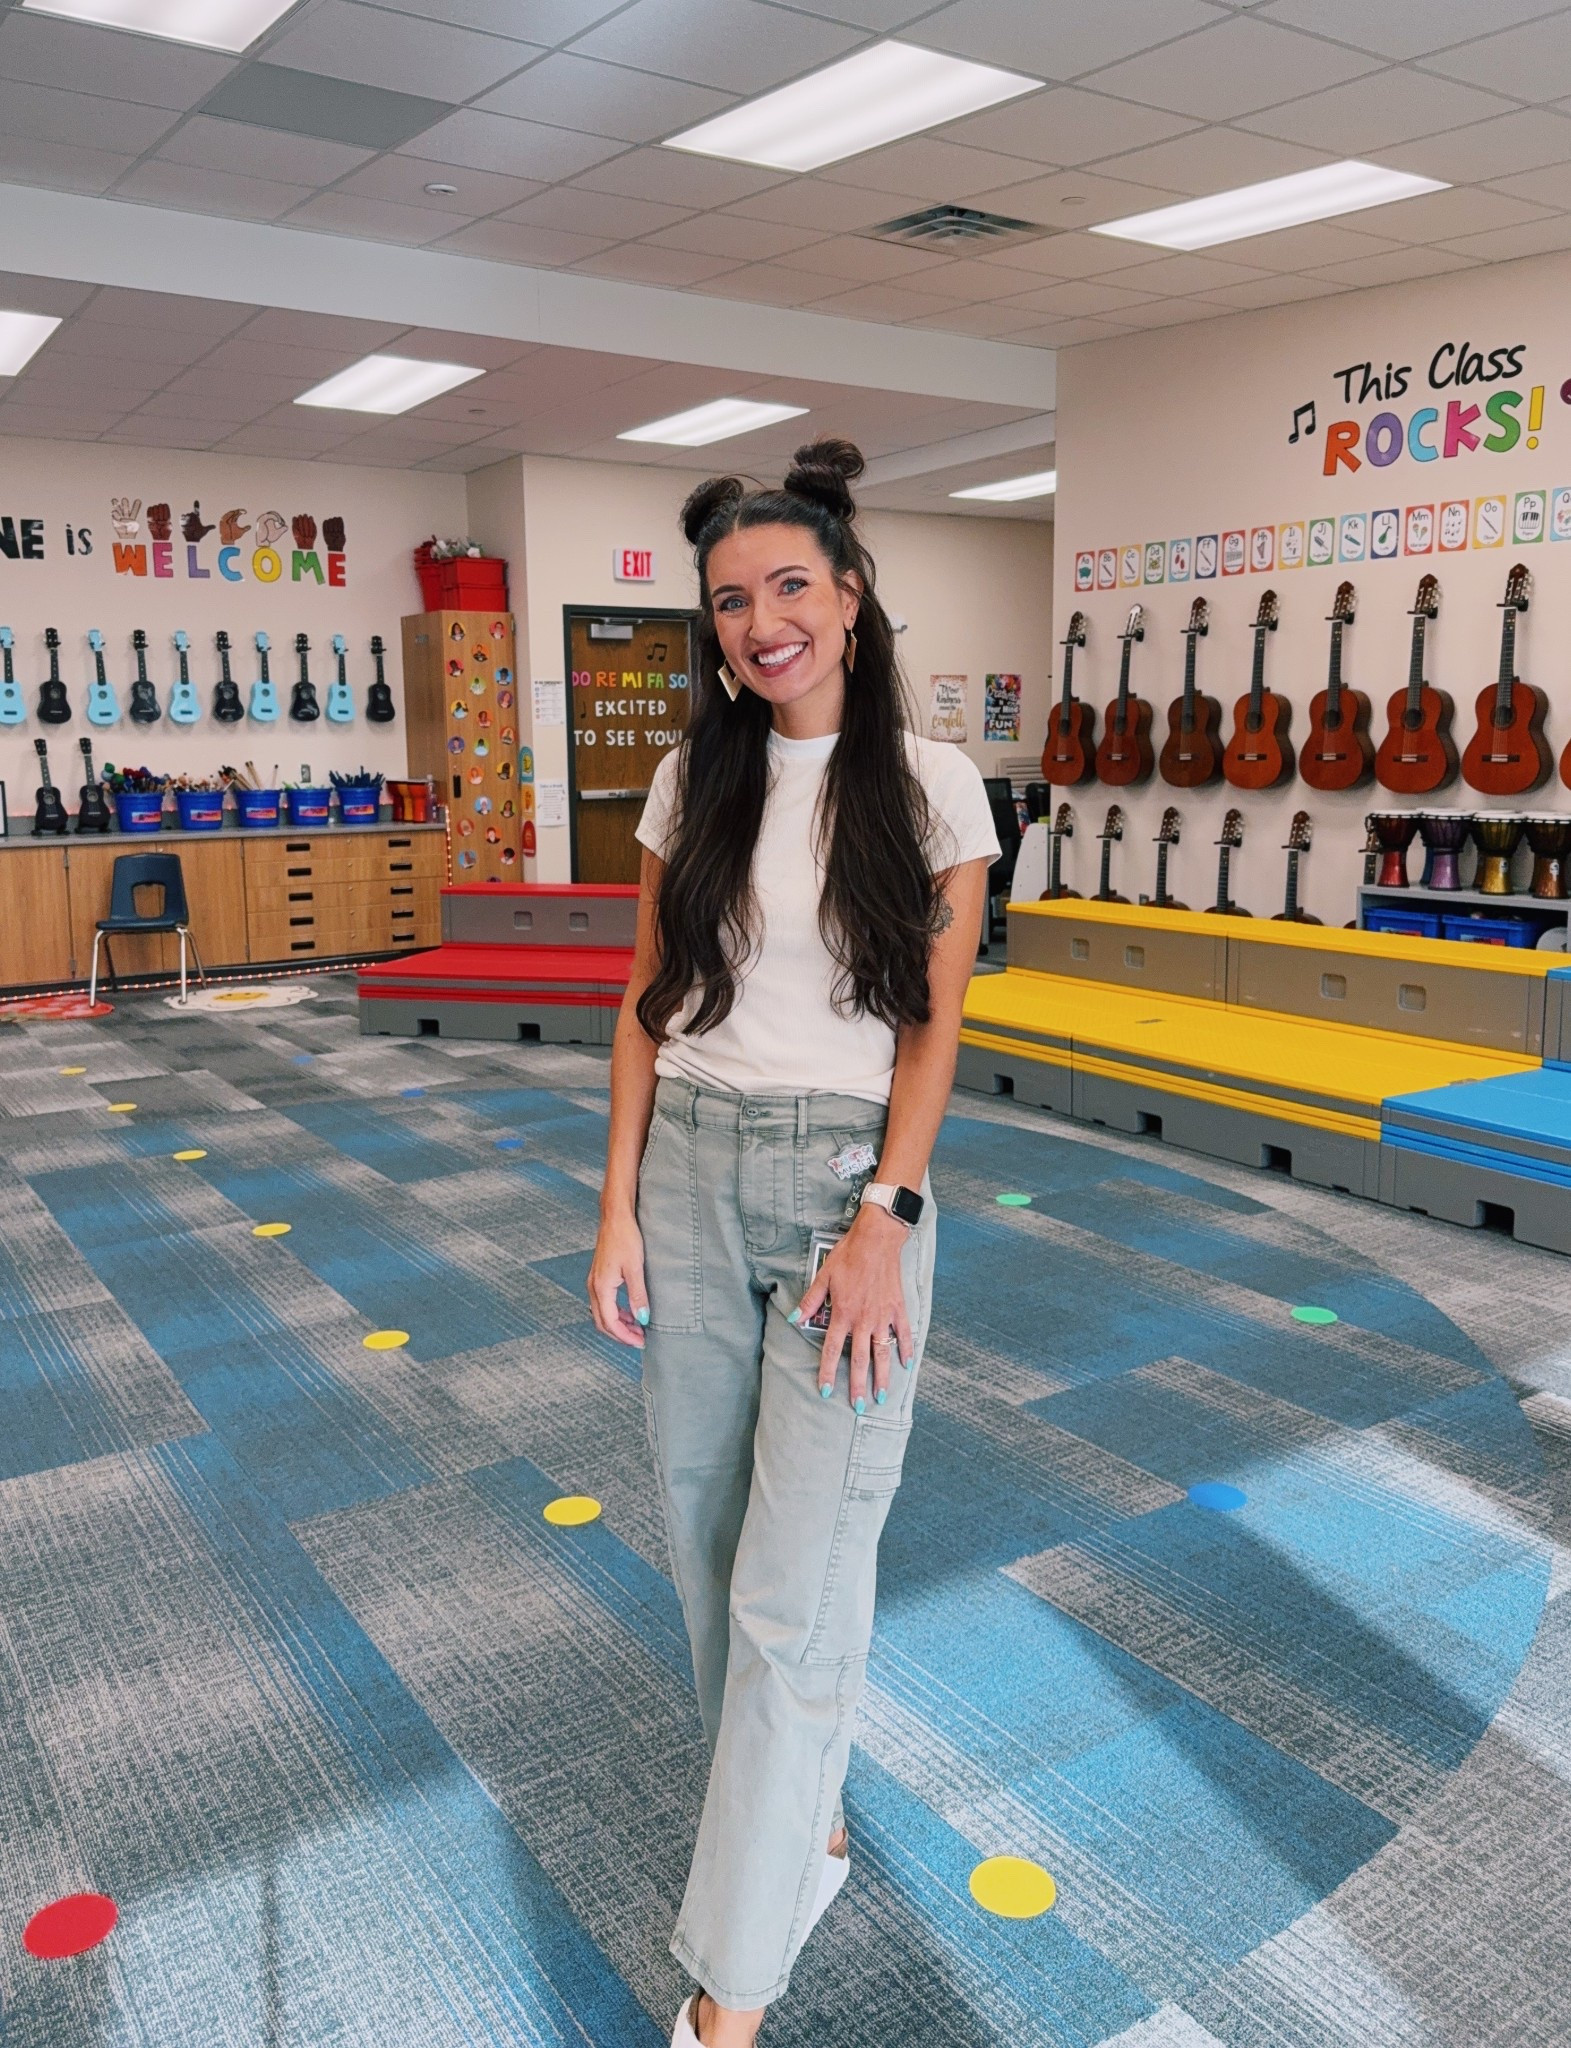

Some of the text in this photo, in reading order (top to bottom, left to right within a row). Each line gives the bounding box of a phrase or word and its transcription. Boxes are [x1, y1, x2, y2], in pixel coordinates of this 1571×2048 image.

[1333, 341, 1527, 404] This Class
[1323, 385, 1545, 476] ROCKS!
[1523, 496, 1537, 510] Pp
[66, 523, 93, 555] is
[112, 542, 346, 587] WELCOME
[623, 550, 652, 578] EXIT
[572, 671, 591, 687] DO
[596, 671, 617, 688] RE
[622, 671, 642, 689] MI
[647, 672, 664, 688] FA
[668, 673, 688, 689] SO
[595, 700, 667, 717] EXCITED
[989, 720, 1013, 729] FUN
[574, 730, 596, 746] TO
[606, 729, 635, 746] SEE
